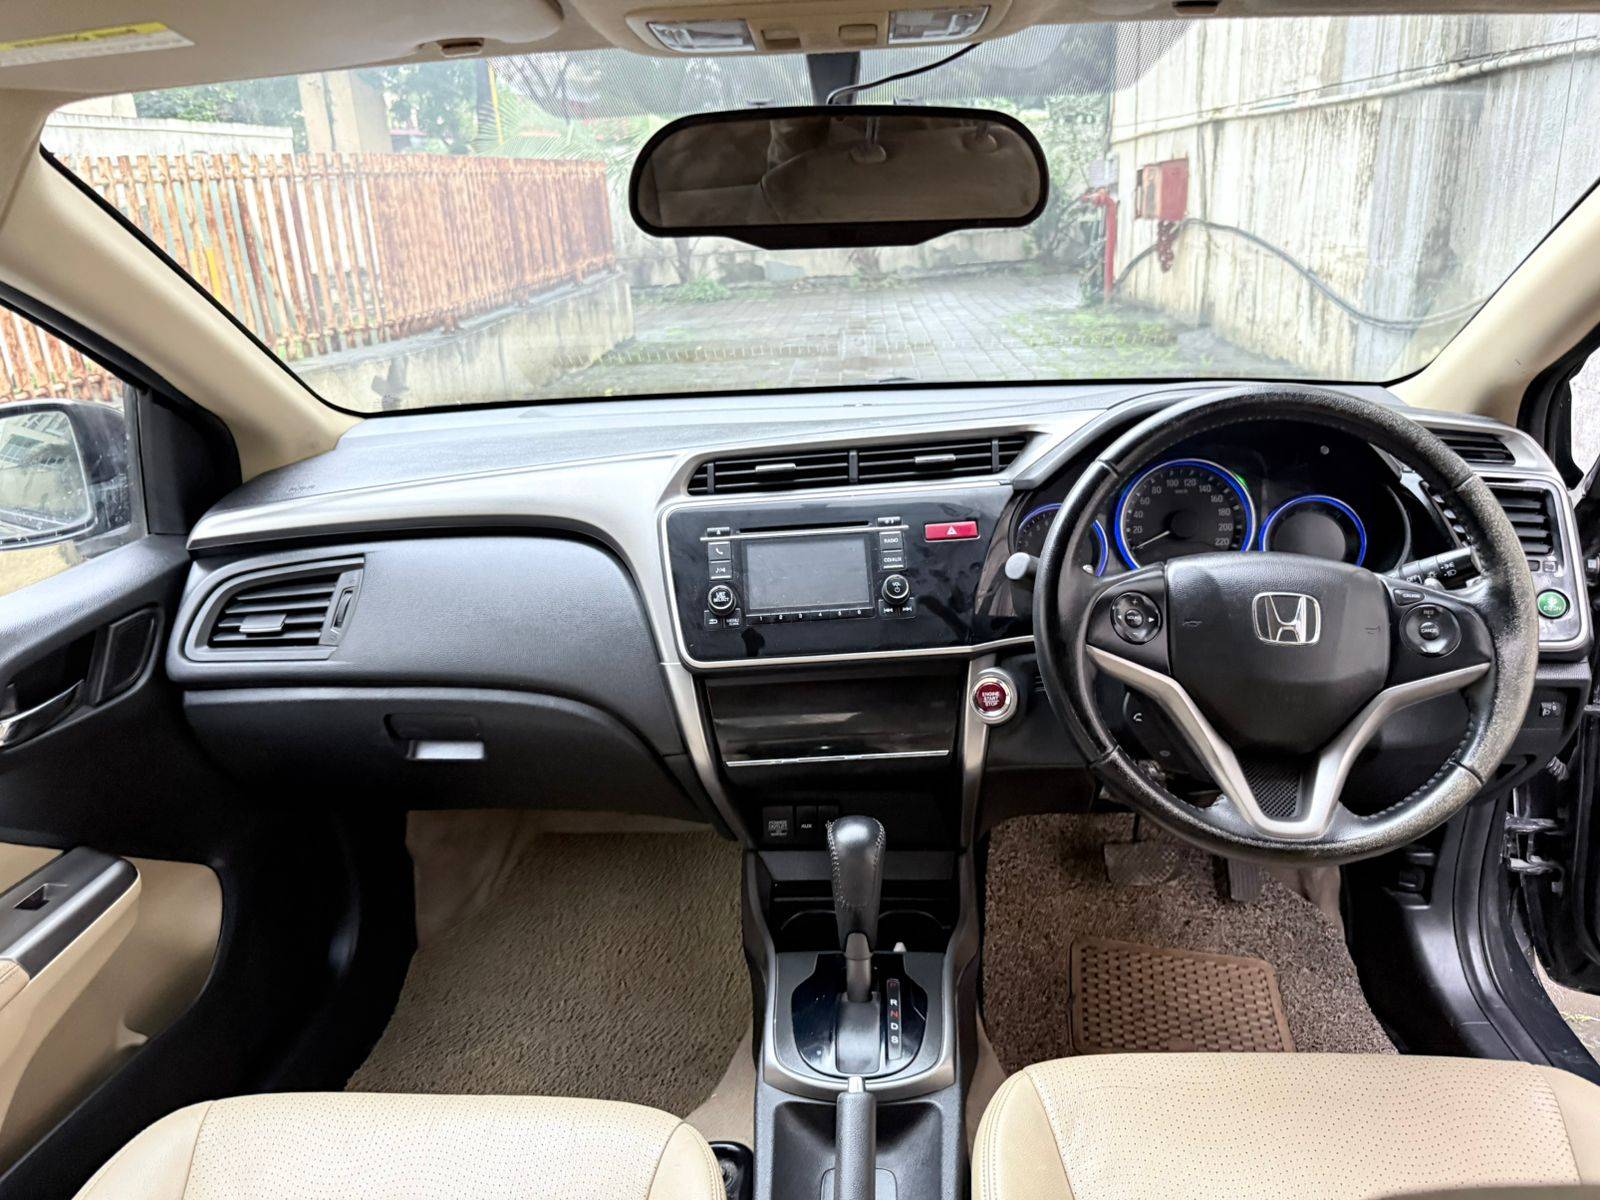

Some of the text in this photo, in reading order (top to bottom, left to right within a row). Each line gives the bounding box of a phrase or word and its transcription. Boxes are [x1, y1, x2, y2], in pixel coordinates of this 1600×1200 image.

[1184, 479, 1197, 487] 120
[1151, 486, 1162, 494] 80
[1199, 485, 1212, 493] 140
[1140, 497, 1150, 505] 60
[1210, 494, 1224, 503] 160
[1218, 508, 1231, 516] 180
[1133, 526, 1143, 534] 20
[1218, 523, 1233, 531] 200
[1215, 538, 1230, 546] 220
[890, 1011, 899, 1019] N
[890, 1022, 899, 1030] D
